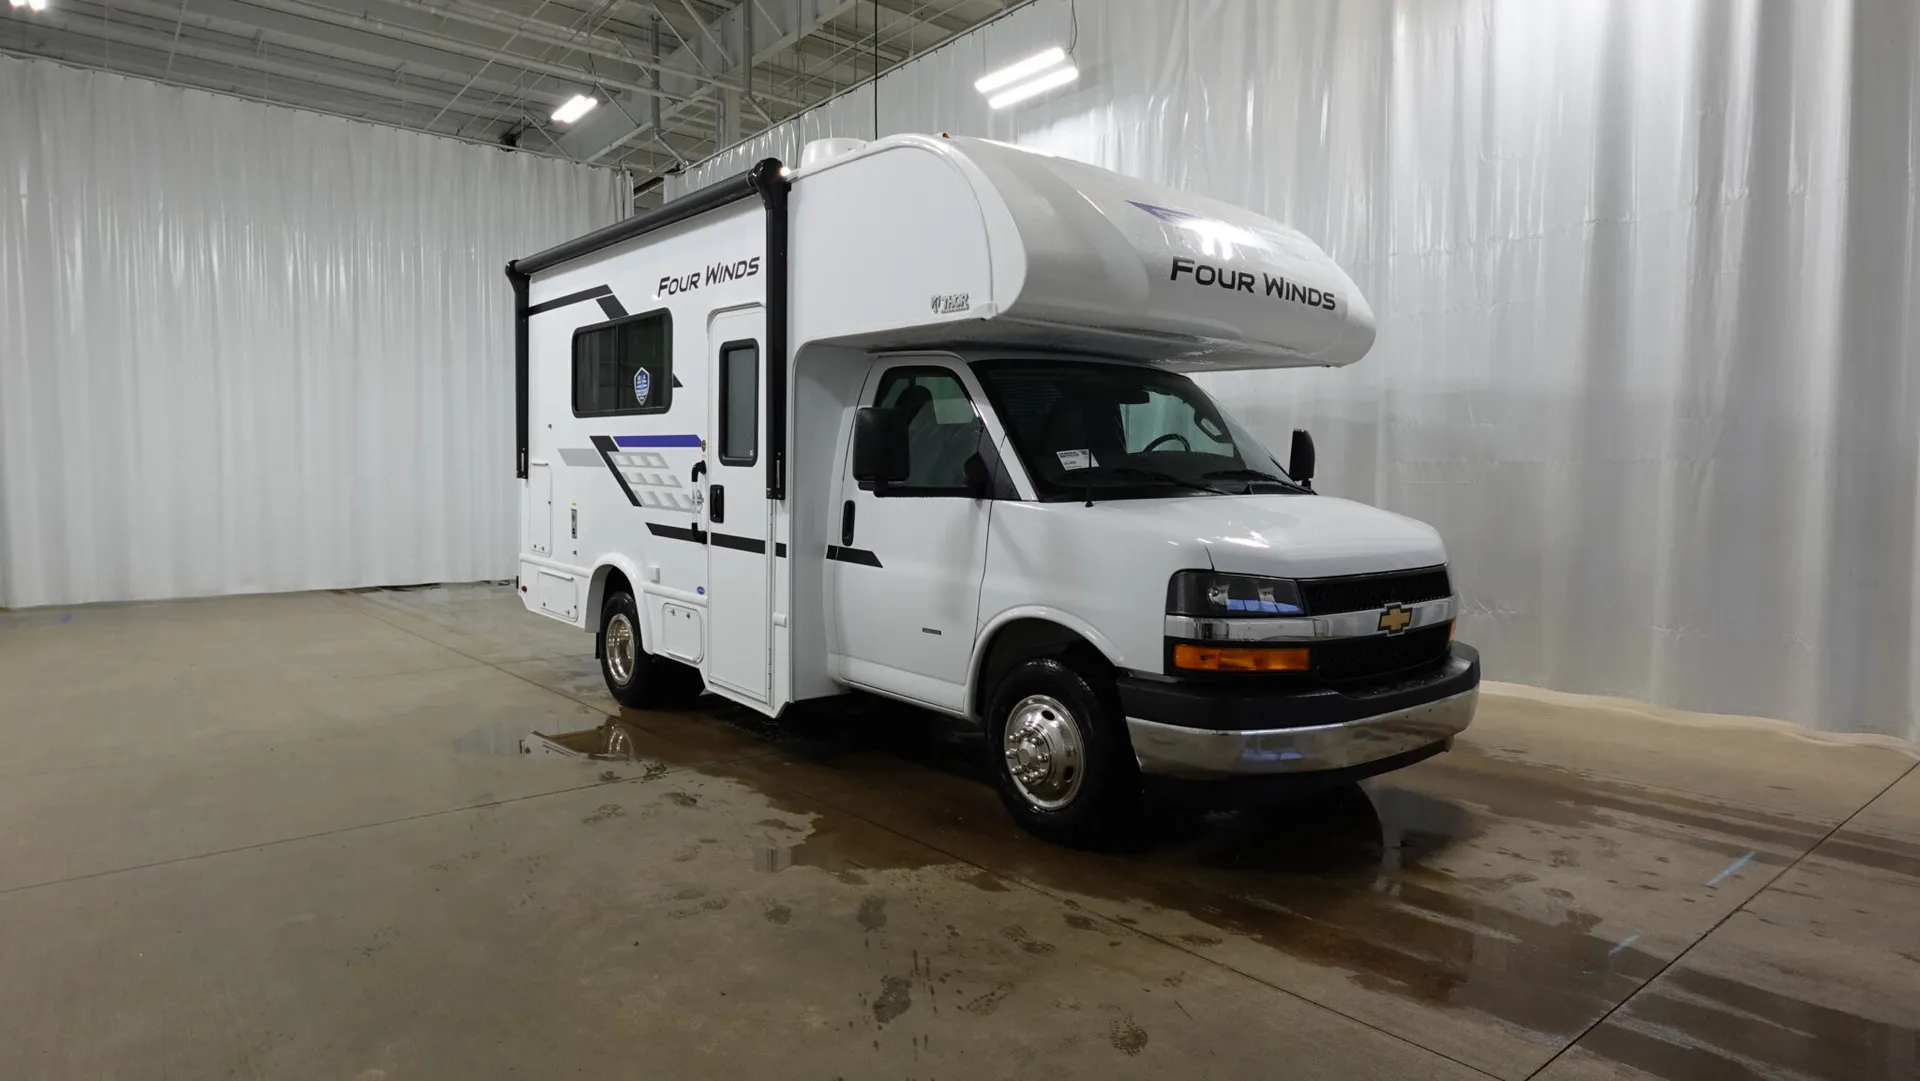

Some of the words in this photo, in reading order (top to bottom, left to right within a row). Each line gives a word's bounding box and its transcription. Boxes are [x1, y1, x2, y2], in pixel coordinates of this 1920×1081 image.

[658, 273, 701, 298] FOUR
[705, 256, 760, 286] WINDS
[1170, 256, 1255, 293] FOUR
[1263, 272, 1335, 310] WINDS
